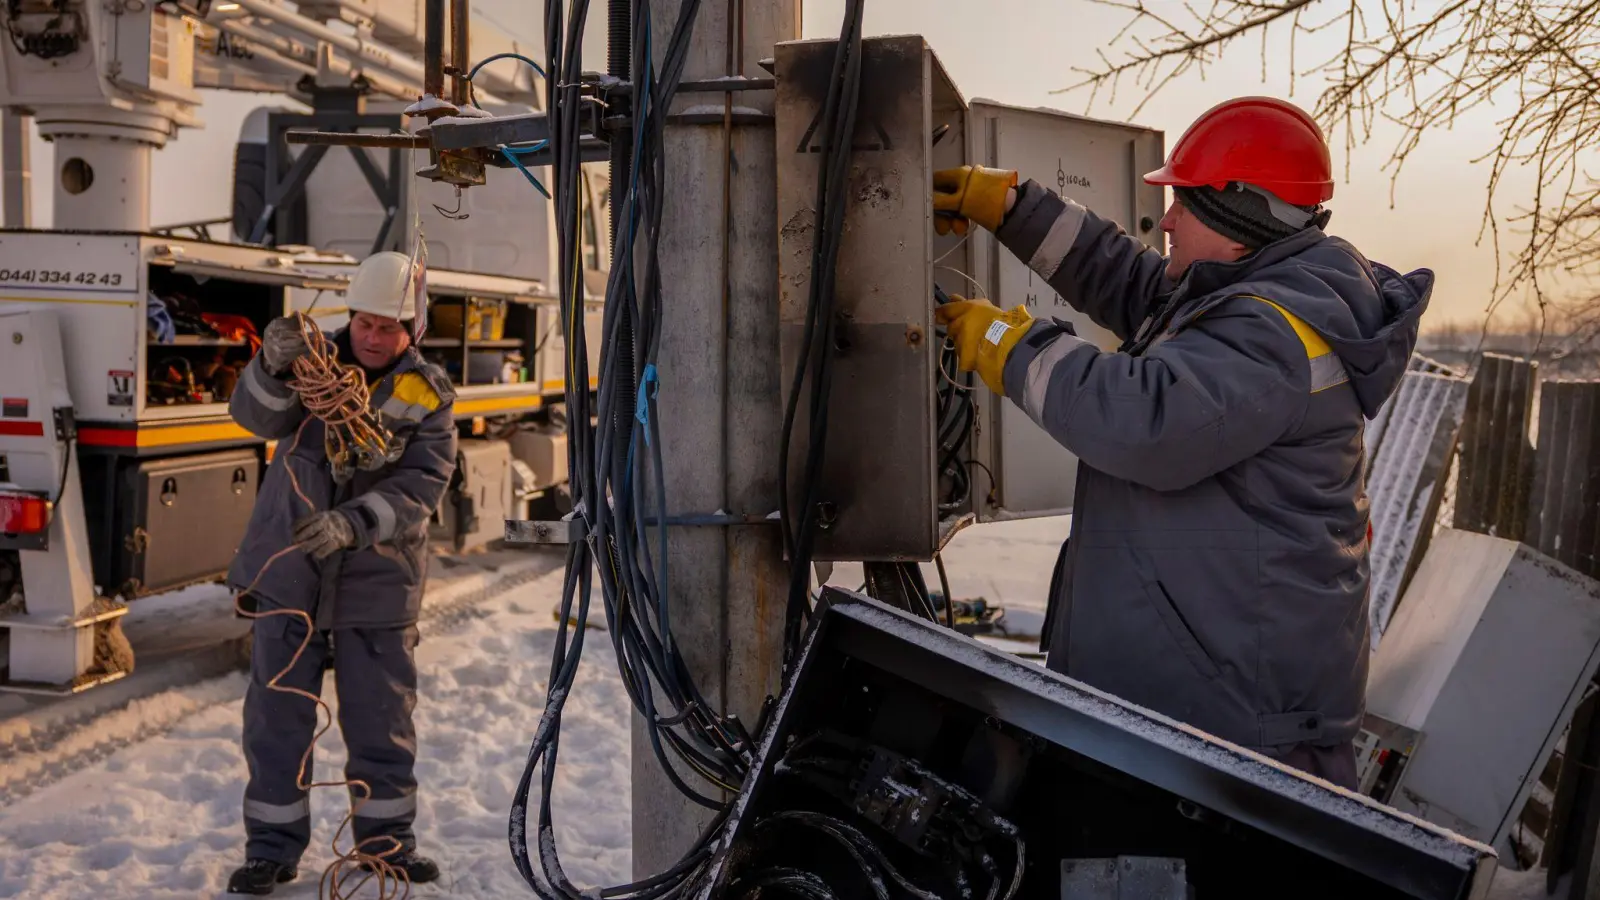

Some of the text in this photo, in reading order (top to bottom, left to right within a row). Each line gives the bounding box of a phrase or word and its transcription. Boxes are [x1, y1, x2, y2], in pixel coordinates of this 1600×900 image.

[39, 270, 71, 283] 334
[74, 271, 96, 285] 42
[99, 273, 122, 286] 43
